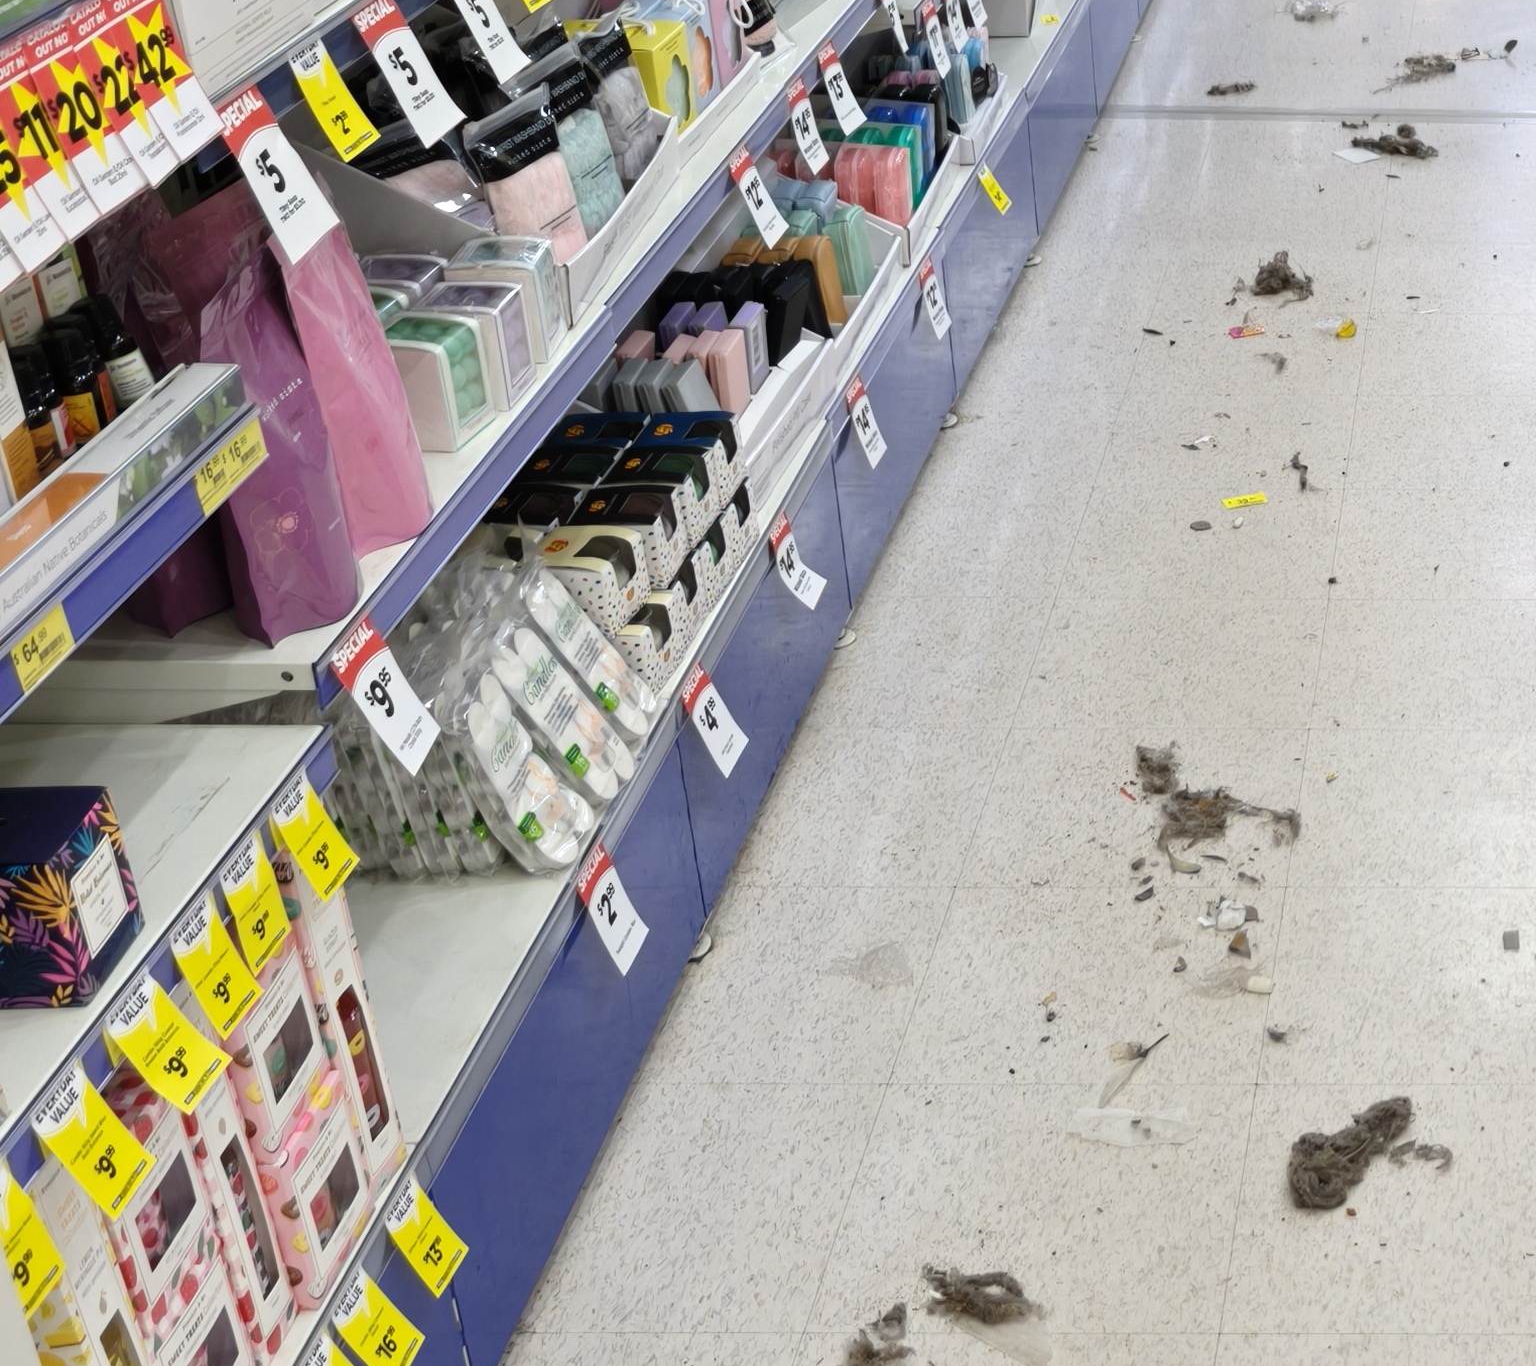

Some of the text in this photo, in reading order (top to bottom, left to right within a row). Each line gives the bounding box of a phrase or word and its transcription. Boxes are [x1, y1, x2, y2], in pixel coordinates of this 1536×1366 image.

[79, 17, 96, 35] OUT
[35, 40, 52, 58] OUT
[389, 46, 418, 86] $5
[256, 149, 286, 193] $5
[730, 146, 748, 171] SPECIAL
[770, 518, 788, 543] SPECIAL
[2, 509, 108, 611] Australian Native Botanicals
[331, 621, 374, 675] SPECIAL
[682, 667, 704, 702] SPECIAL
[578, 848, 604, 892] SPECIAL
[253, 999, 284, 1044] SWEET TREATS
[300, 1147, 331, 1194] SWEET TREATS
[186, 1315, 204, 1342] TREATS
